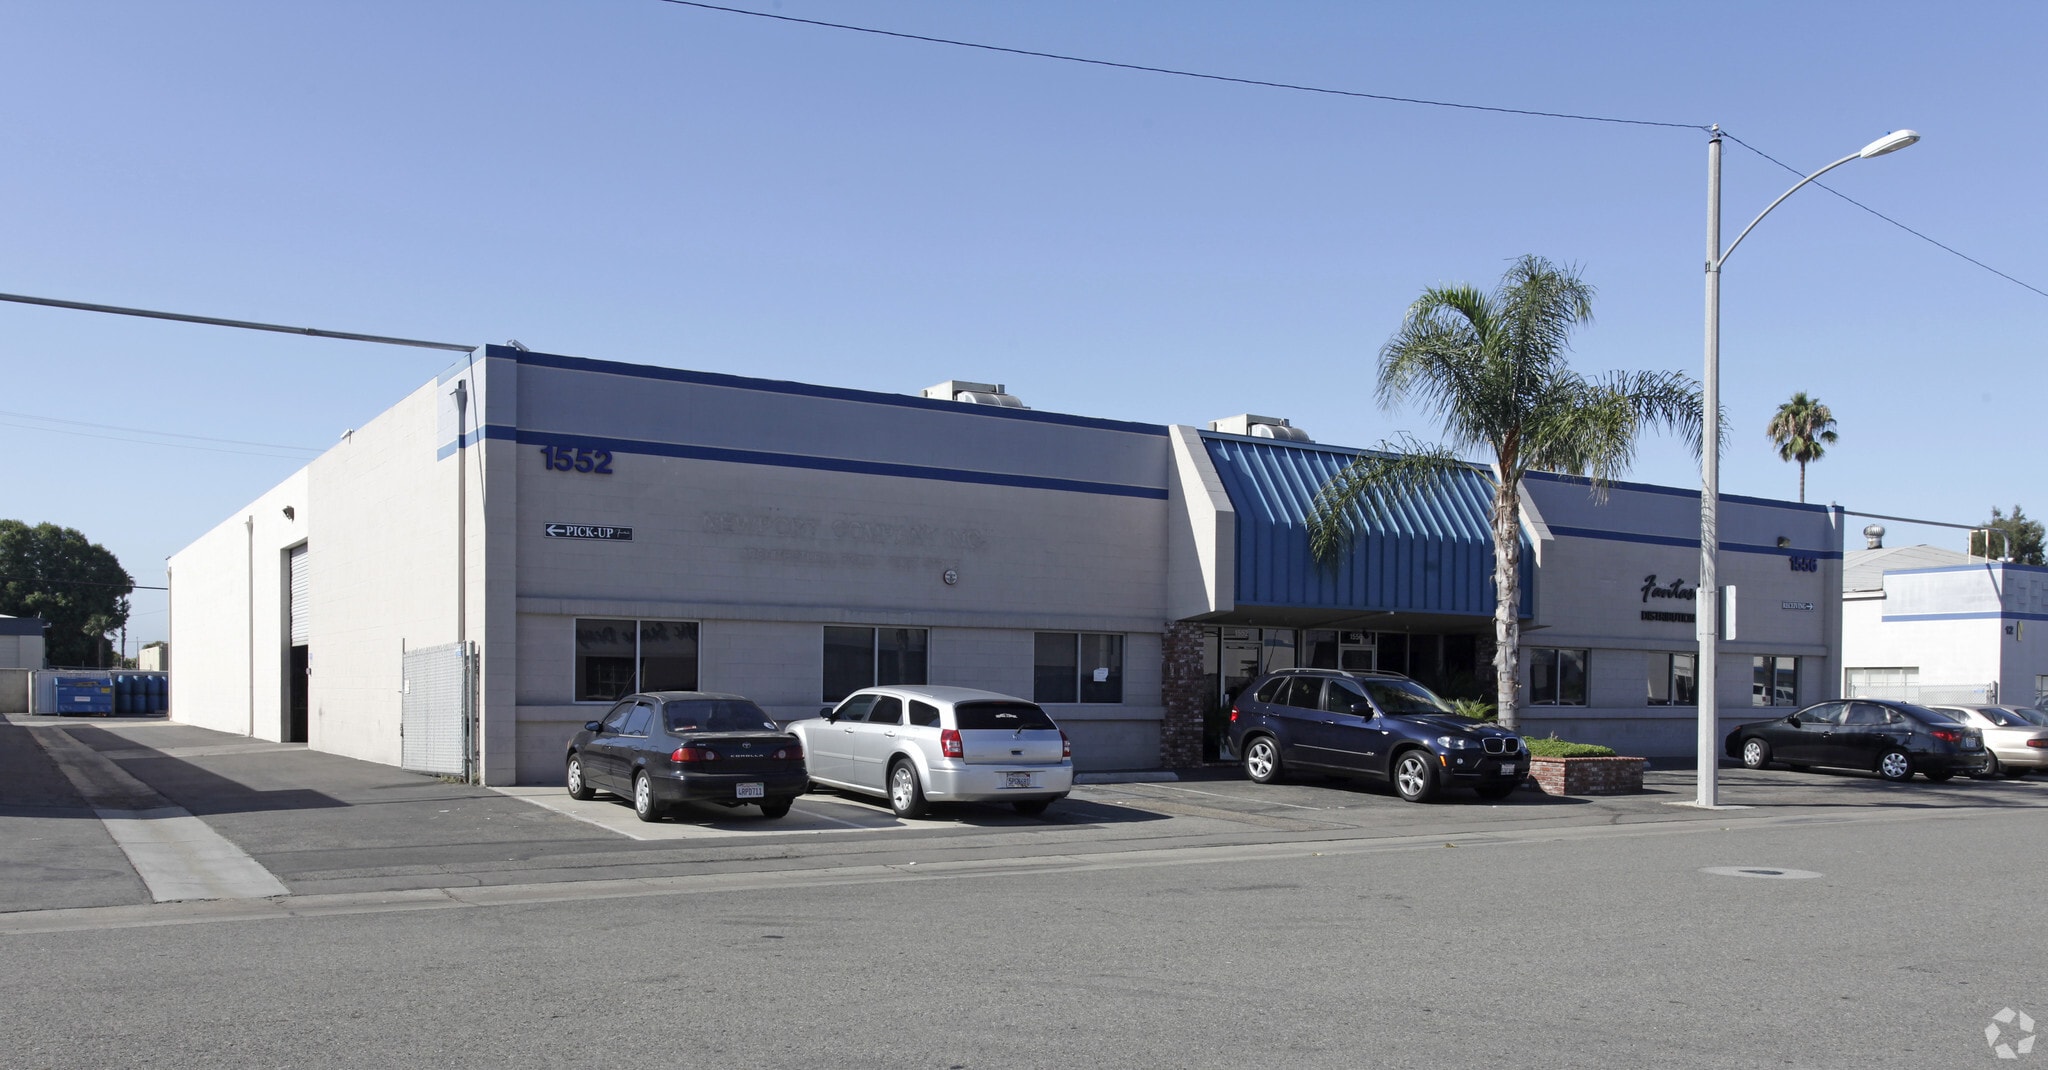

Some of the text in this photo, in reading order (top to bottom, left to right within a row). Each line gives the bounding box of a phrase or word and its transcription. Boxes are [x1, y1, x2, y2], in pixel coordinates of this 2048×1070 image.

[541, 444, 613, 475] 1552
[566, 525, 614, 538] PICK-UP
[1789, 556, 1818, 573] 1556
